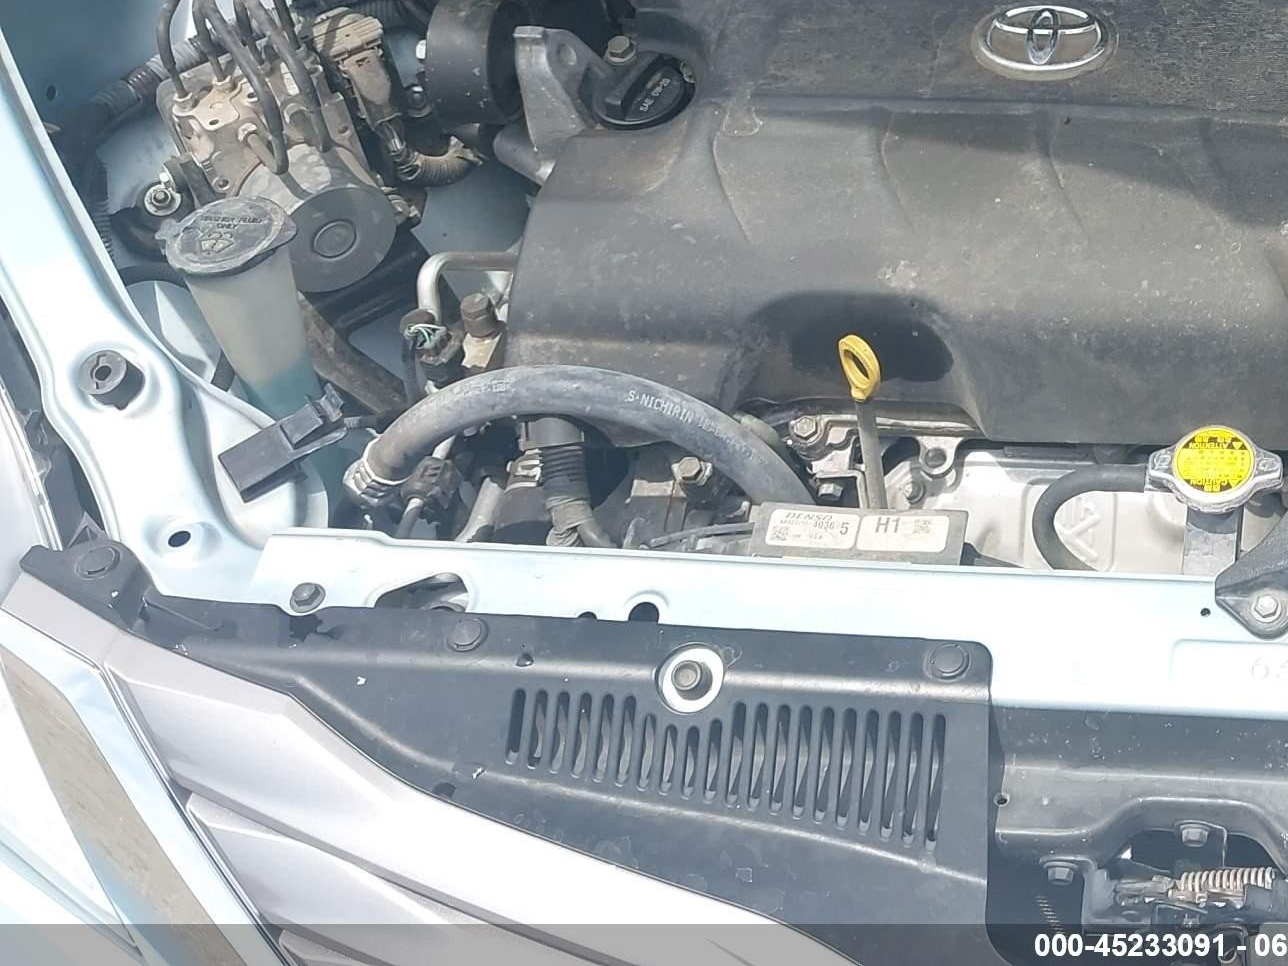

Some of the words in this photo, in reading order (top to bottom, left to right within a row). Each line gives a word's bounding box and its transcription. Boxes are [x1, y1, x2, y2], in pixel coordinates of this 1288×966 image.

[1188, 442, 1229, 450] ATTENTION
[1190, 478, 1229, 486] CAUTION
[785, 512, 834, 521] DENSO
[839, 522, 850, 536] 5
[874, 517, 900, 534] H1
